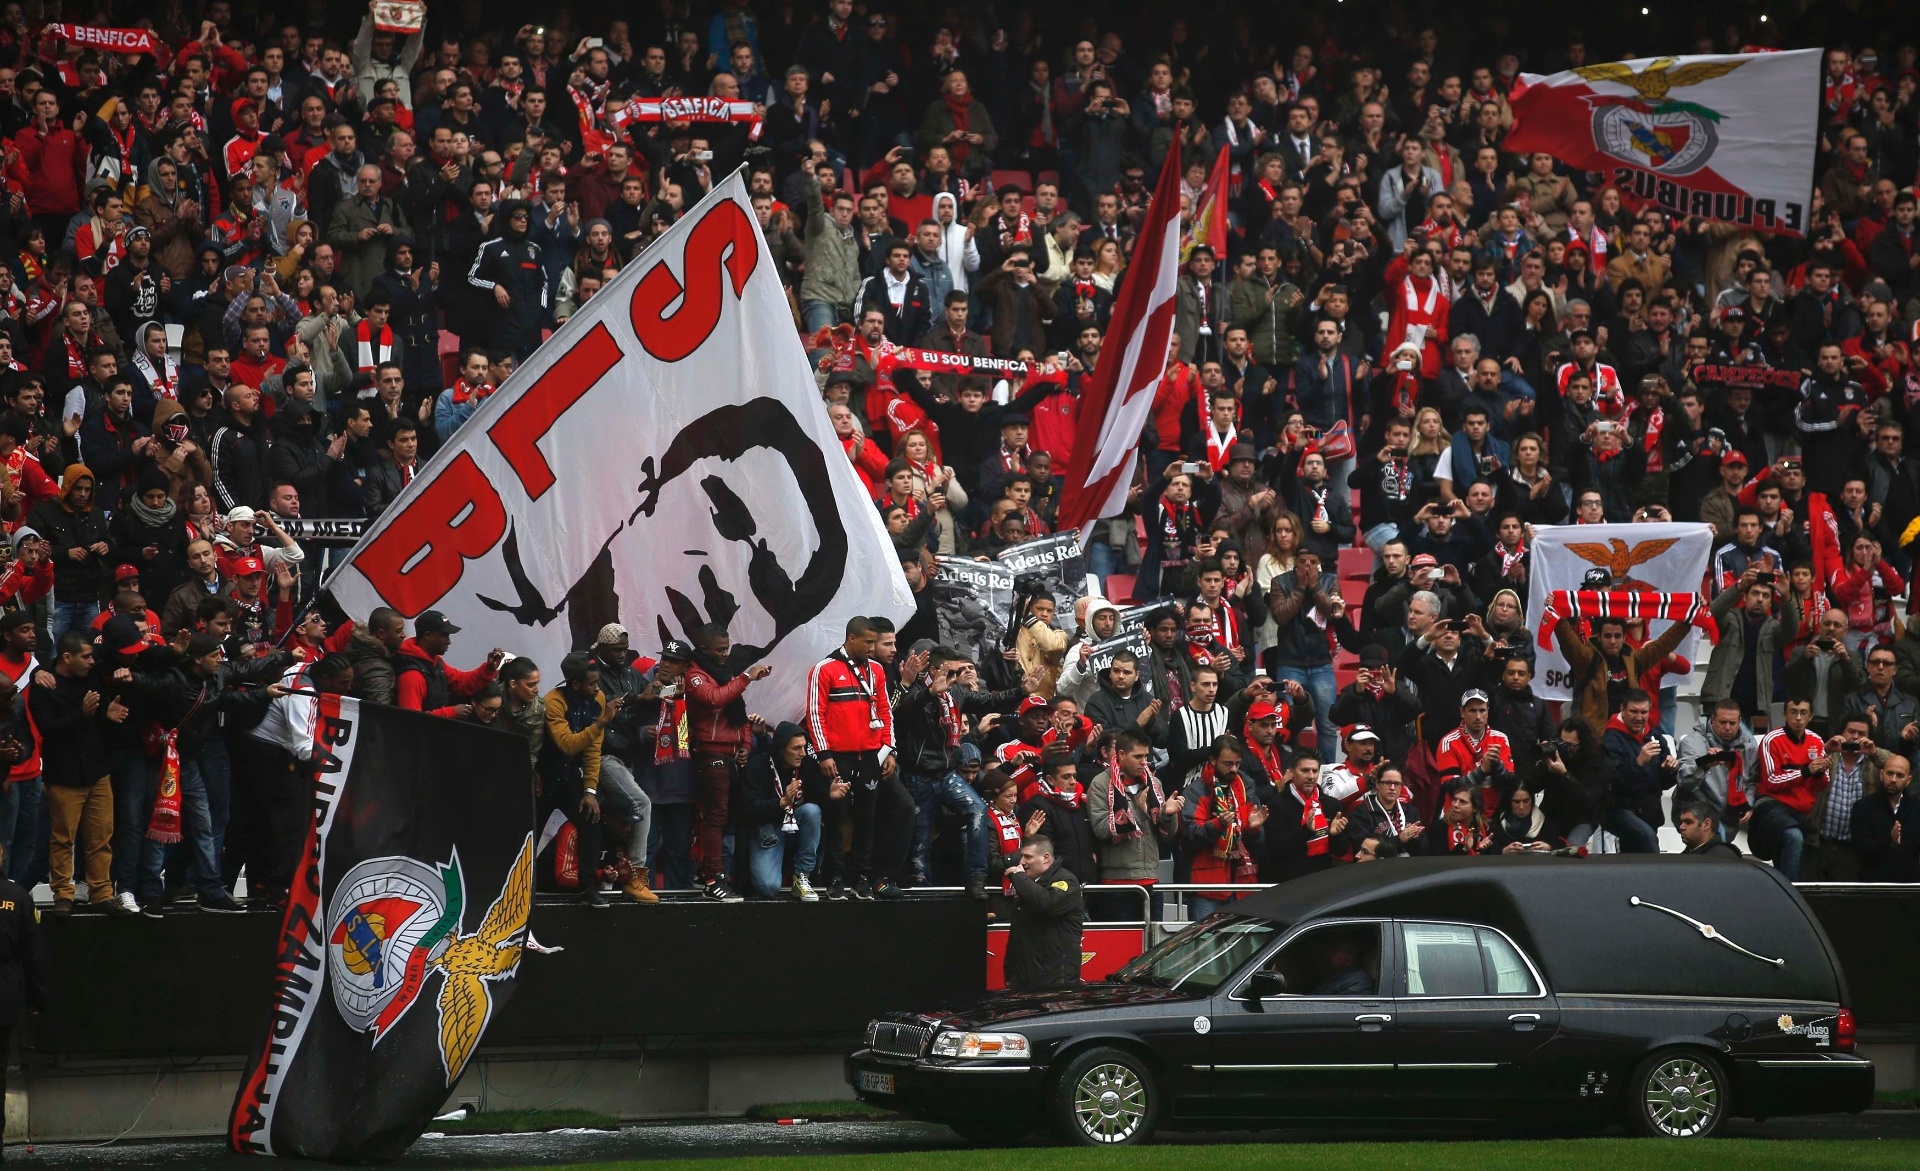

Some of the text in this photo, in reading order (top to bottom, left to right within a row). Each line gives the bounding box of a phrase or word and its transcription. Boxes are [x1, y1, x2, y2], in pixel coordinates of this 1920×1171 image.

[74, 25, 150, 48] BENFICA
[661, 97, 731, 121] BENFICA
[923, 352, 1029, 372] EU SOU BENFICA
[352, 197, 758, 619] SLB
[1005, 542, 1082, 573] Adeus Rei
[934, 566, 1015, 590] Adeus Rei
[1195, 1020, 1209, 1030] 307
